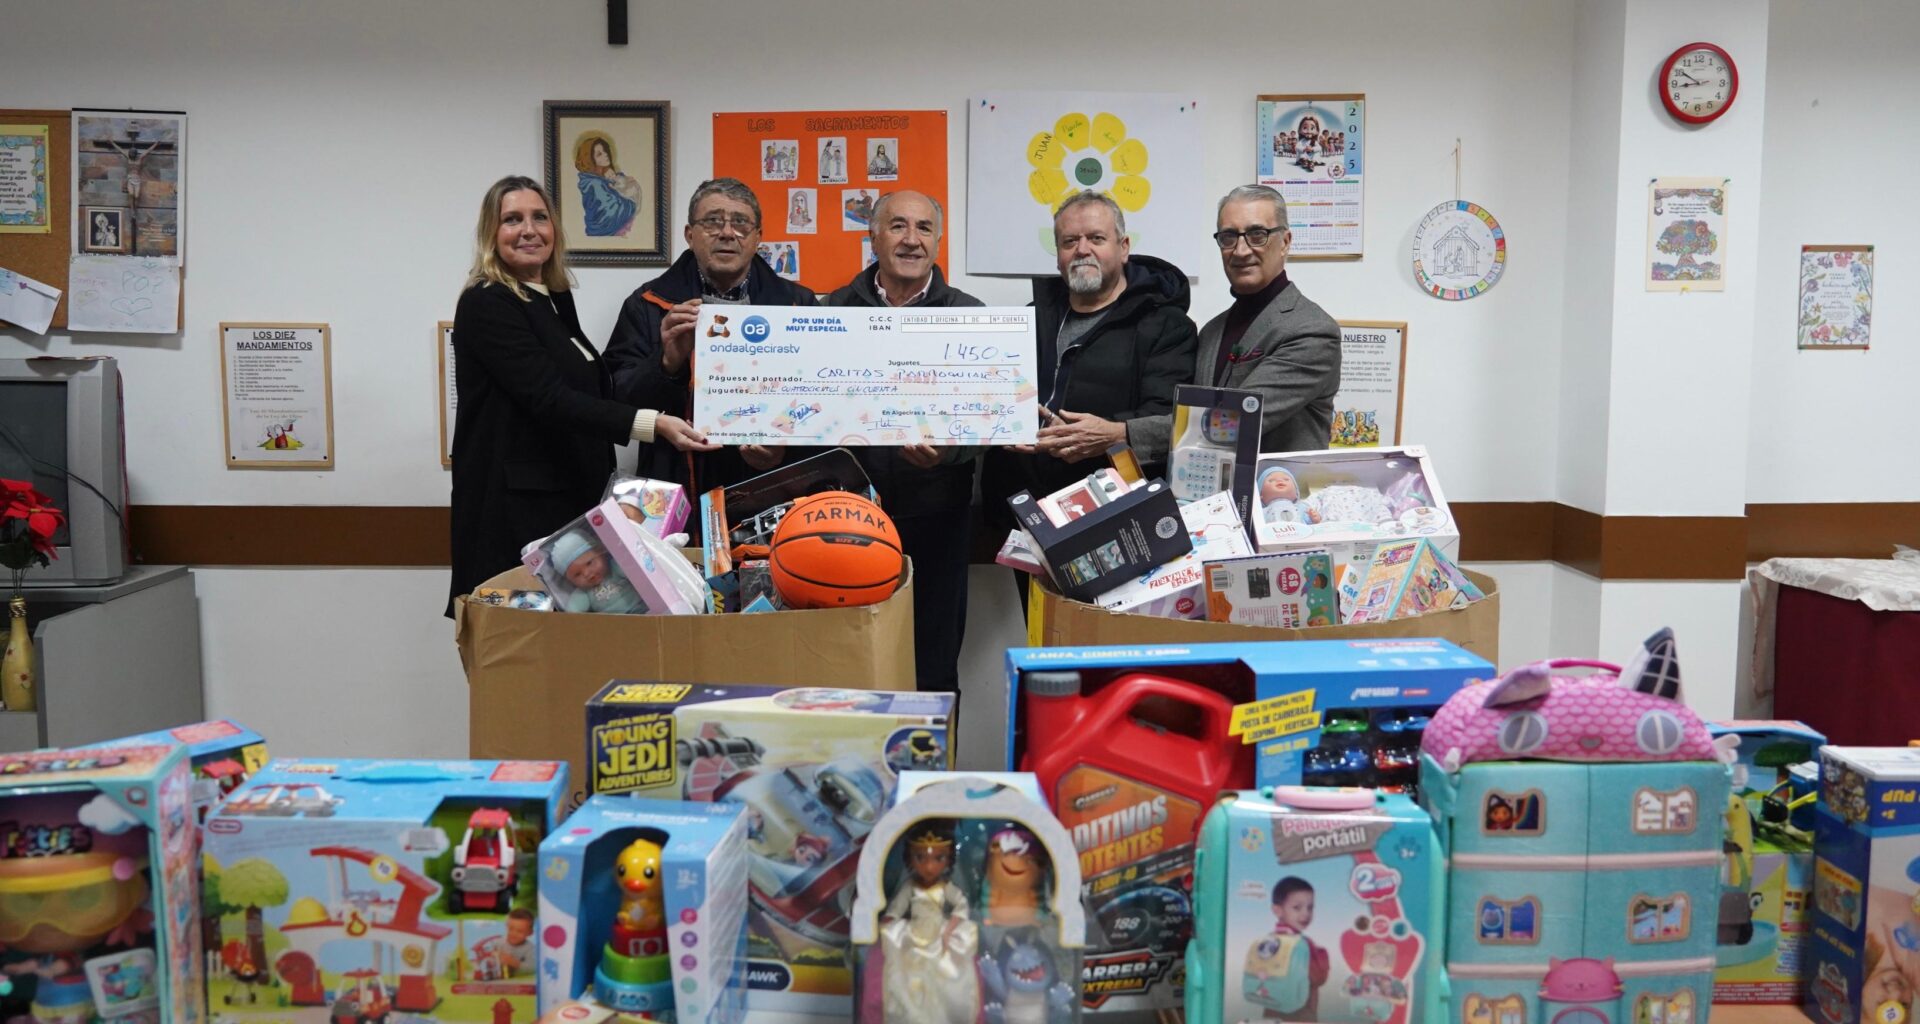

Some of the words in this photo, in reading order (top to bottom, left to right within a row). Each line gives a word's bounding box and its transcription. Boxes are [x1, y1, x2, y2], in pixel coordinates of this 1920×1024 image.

[1683, 59, 1692, 67] 11
[1694, 55, 1705, 63] 12
[1709, 58, 1713, 66] 1
[1671, 80, 1678, 89] 9
[1719, 79, 1726, 87] 3
[1674, 92, 1680, 101] 8
[1715, 92, 1721, 100] 4
[1682, 101, 1689, 110] 7
[1695, 104, 1701, 112] 6
[1707, 101, 1713, 109] 5
[747, 118, 776, 133] LOS
[804, 115, 910, 132] SACRAMENTOS
[1034, 132, 1053, 160] JUAN
[792, 317, 809, 325] POR
[826, 316, 842, 325] DÍA
[252, 331, 273, 340] LOS
[275, 331, 297, 340] DIEZ
[744, 322, 766, 336] oa
[1343, 333, 1387, 344] NUESTRO
[236, 341, 313, 351] MANDAMIENTOS
[710, 342, 801, 356] ondaalgecirastv
[708, 374, 748, 384] Páguese
[762, 375, 803, 384] portador
[816, 366, 884, 379] CARITAS
[707, 387, 750, 395] juguetes
[760, 385, 777, 393] MIL
[892, 409, 922, 417] Algeciras
[953, 403, 990, 413] ENERO
[998, 403, 1016, 415] 26
[803, 506, 887, 534] TARMAK
[1272, 524, 1296, 534] Luli
[834, 536, 854, 544] SIZE
[1280, 570, 1288, 592] PIEZAS
[1288, 573, 1299, 589] 68
[1282, 603, 1290, 616] DE
[1262, 715, 1270, 724] DE
[1272, 705, 1311, 722] CARRERAS
[1284, 717, 1315, 732] VERTICAL
[597, 720, 670, 748] YOUNG
[599, 739, 668, 776] JEDI
[598, 767, 672, 790] ADVENTURES
[1882, 789, 1915, 803] PUP
[1074, 794, 1169, 854] DITIVOS
[1302, 827, 1367, 853] portátil
[1080, 825, 1165, 879] OTENTES
[1357, 868, 1376, 892] 2
[1113, 916, 1141, 930] 188
[1082, 961, 1159, 979] ARRERA
[747, 970, 779, 984] AWK
[1082, 977, 1144, 993] XTREMA
